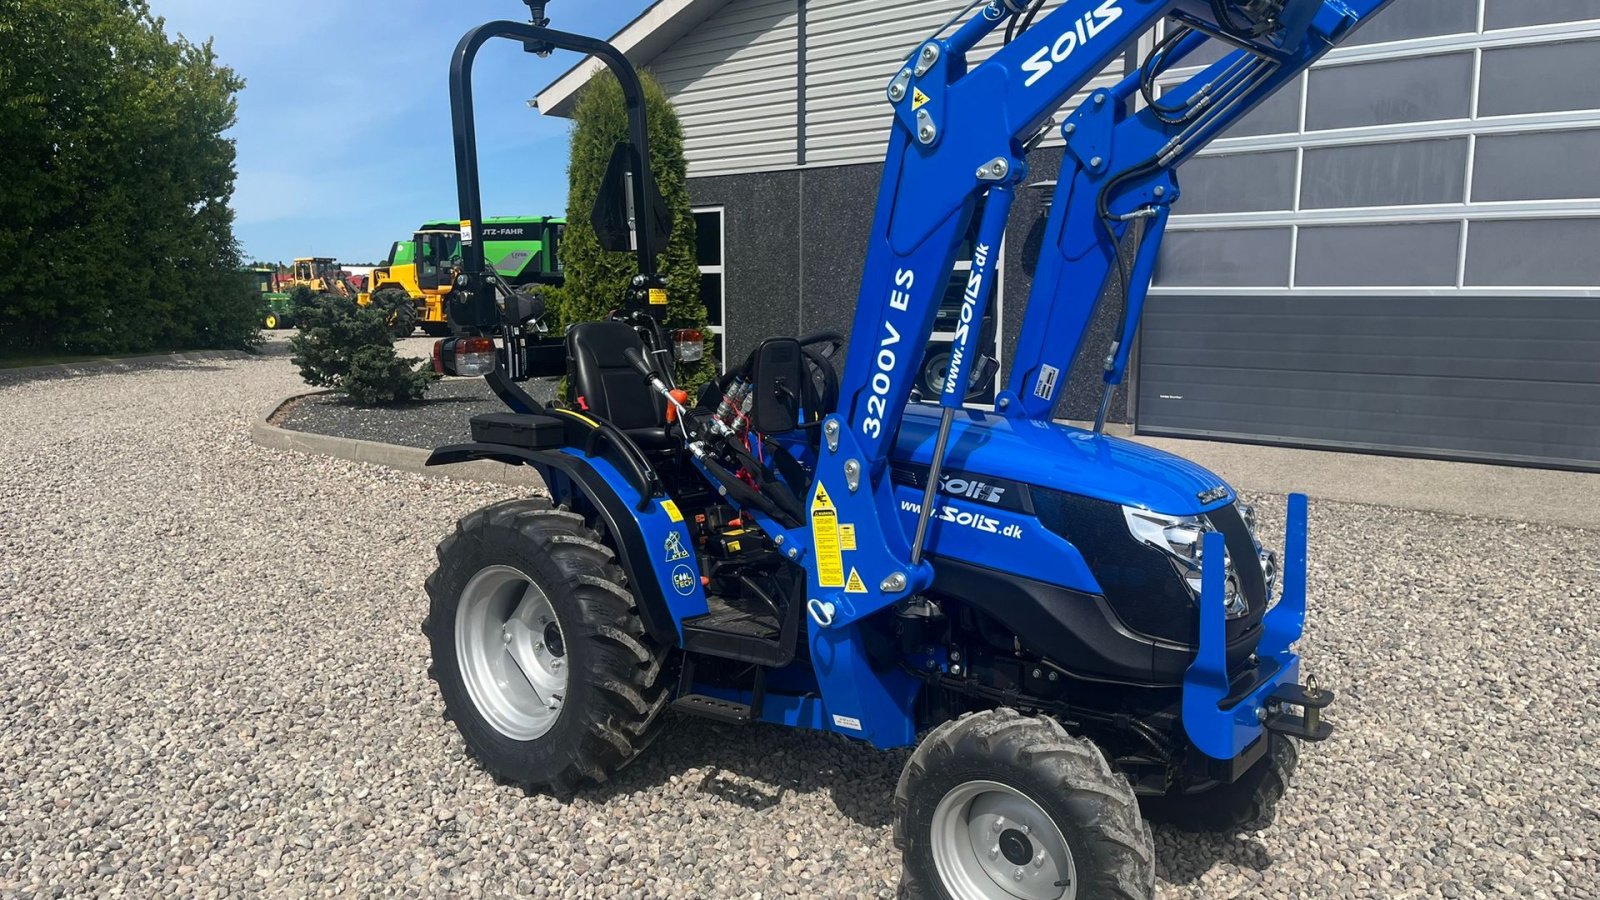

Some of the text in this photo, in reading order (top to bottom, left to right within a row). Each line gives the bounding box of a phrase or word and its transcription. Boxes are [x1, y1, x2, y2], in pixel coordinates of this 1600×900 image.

[863, 268, 914, 439] 3200V ES
[672, 550, 689, 560] PTO
[675, 579, 694, 589] TECH
